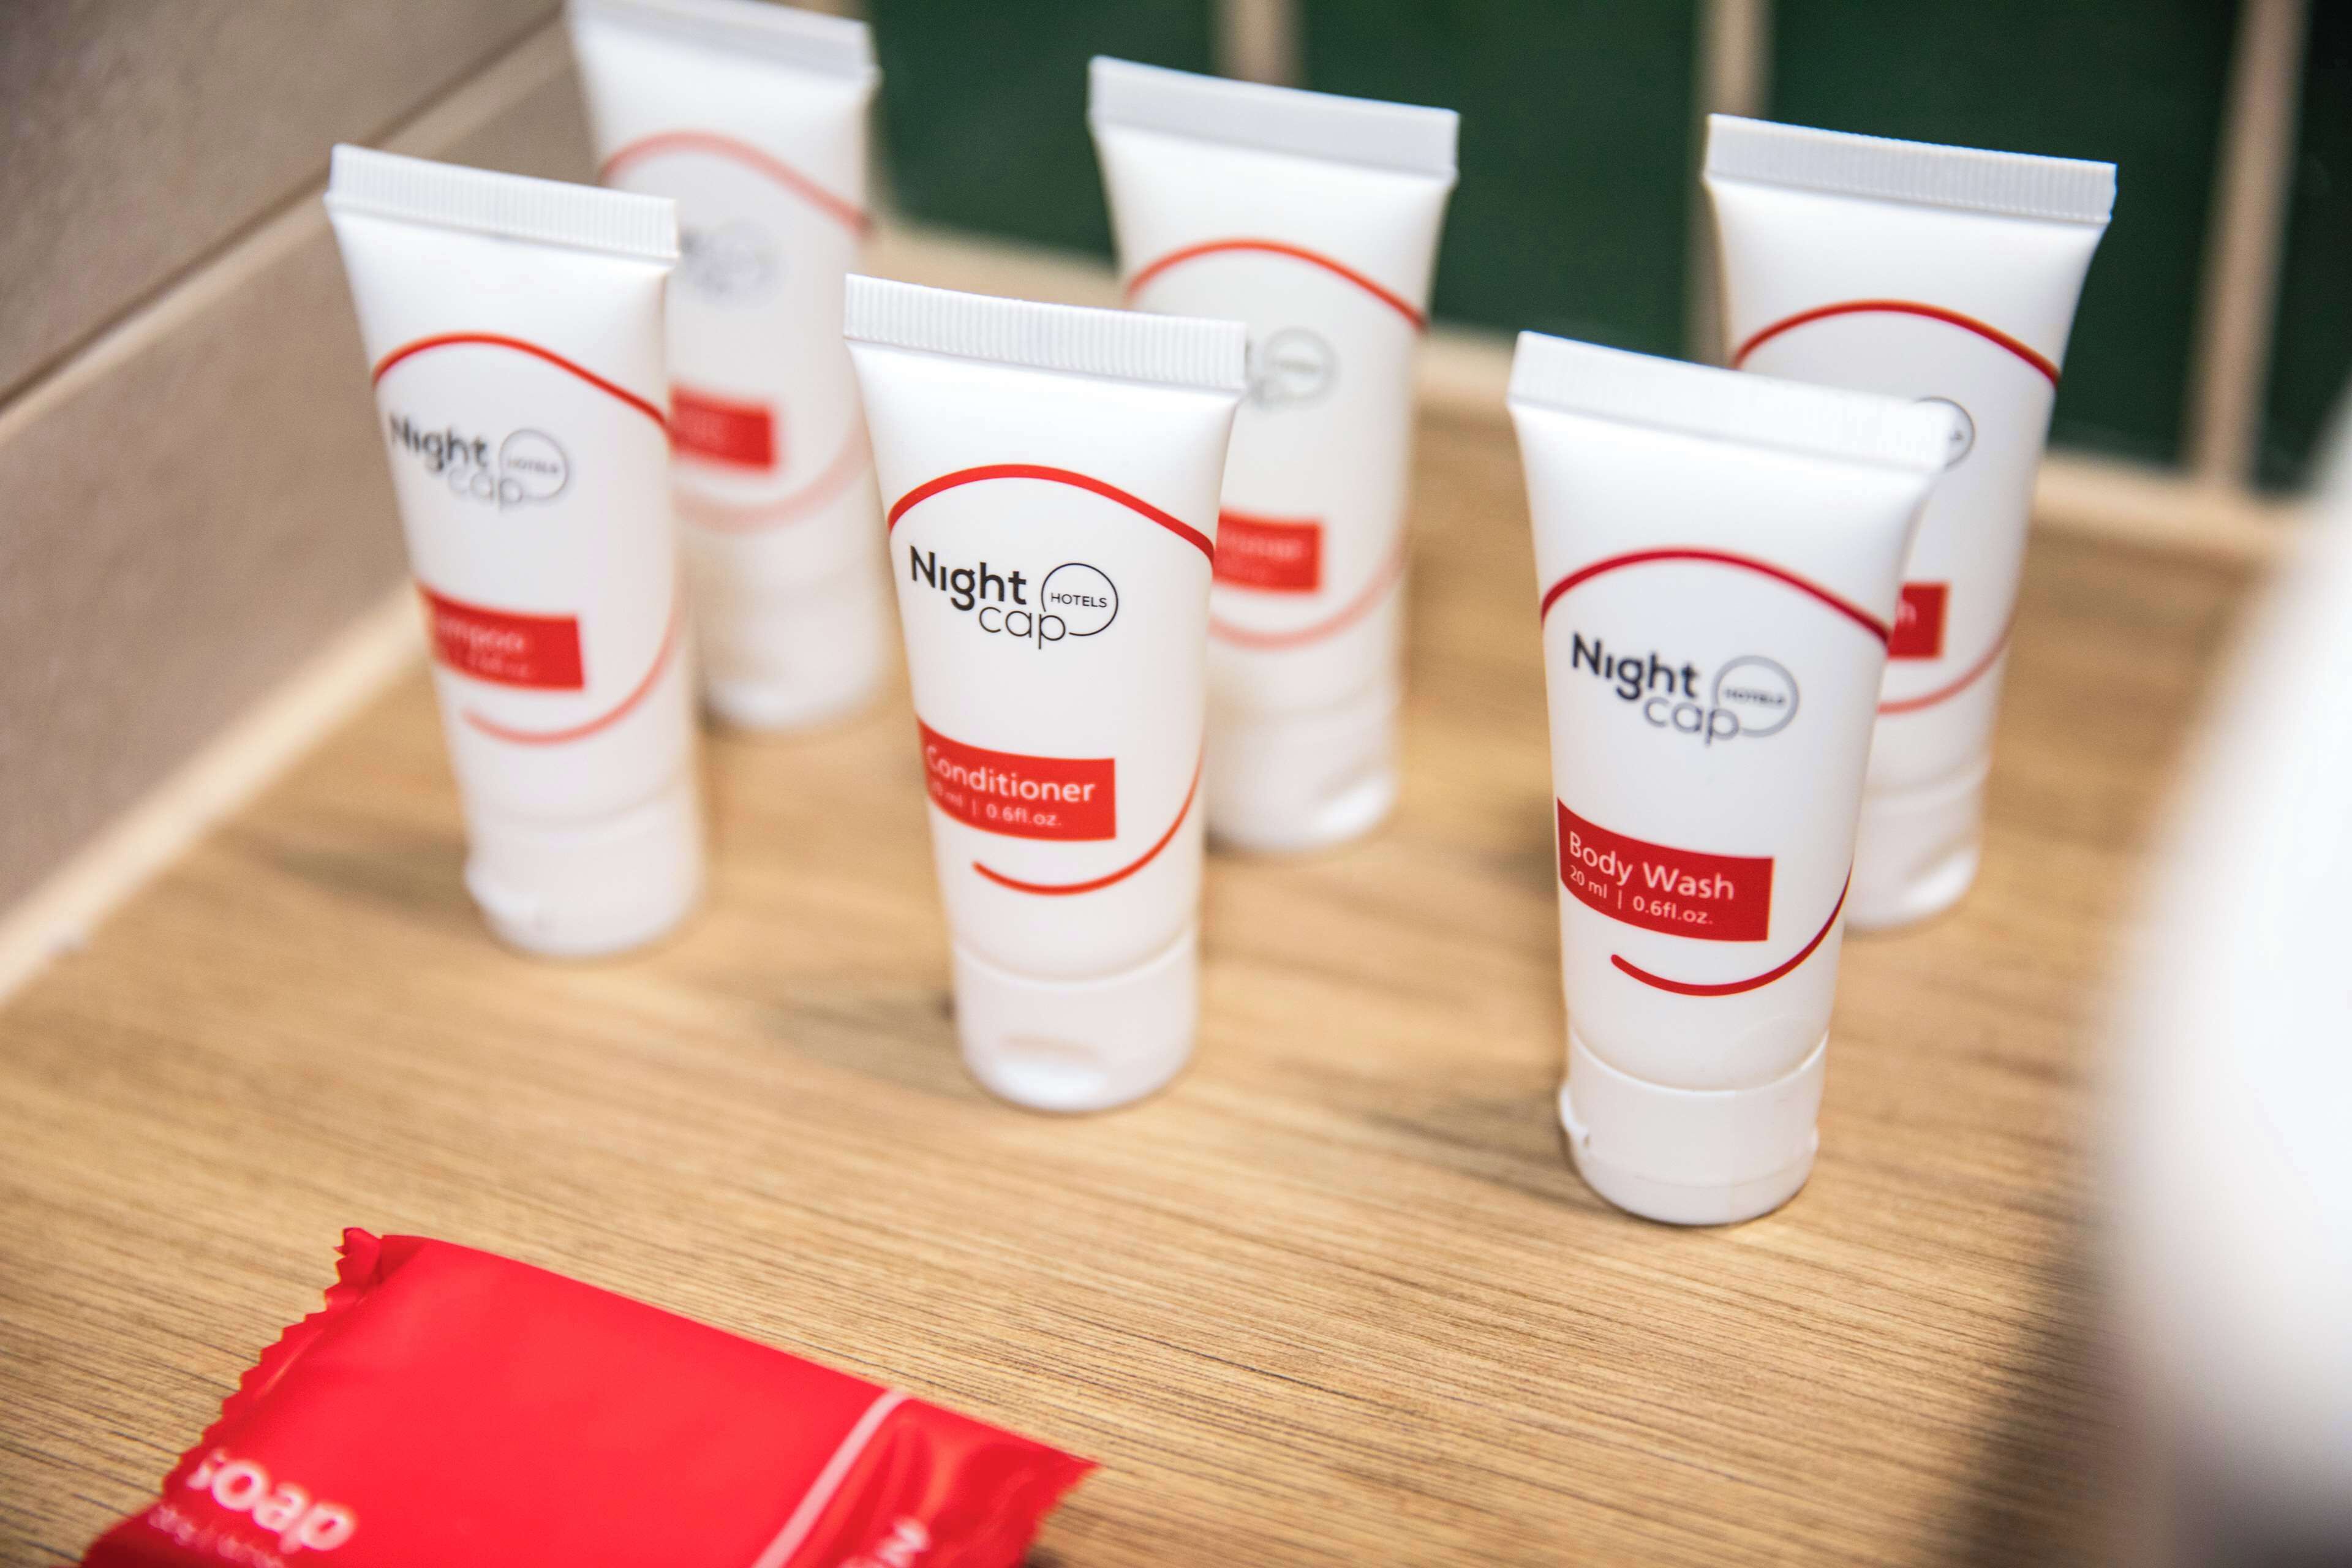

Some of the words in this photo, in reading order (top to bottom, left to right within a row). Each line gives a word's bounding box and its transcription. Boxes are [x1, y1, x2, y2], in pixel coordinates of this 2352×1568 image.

[910, 545, 1027, 611] Night
[1050, 592, 1108, 608] HOTELS
[979, 606, 1066, 650] cap
[1570, 630, 1699, 701] Night
[1643, 696, 1741, 747] cap
[1569, 830, 1634, 886] Body
[1643, 861, 1735, 900] Wash
[1569, 864, 1586, 886] 20
[1588, 879, 1608, 899] ml
